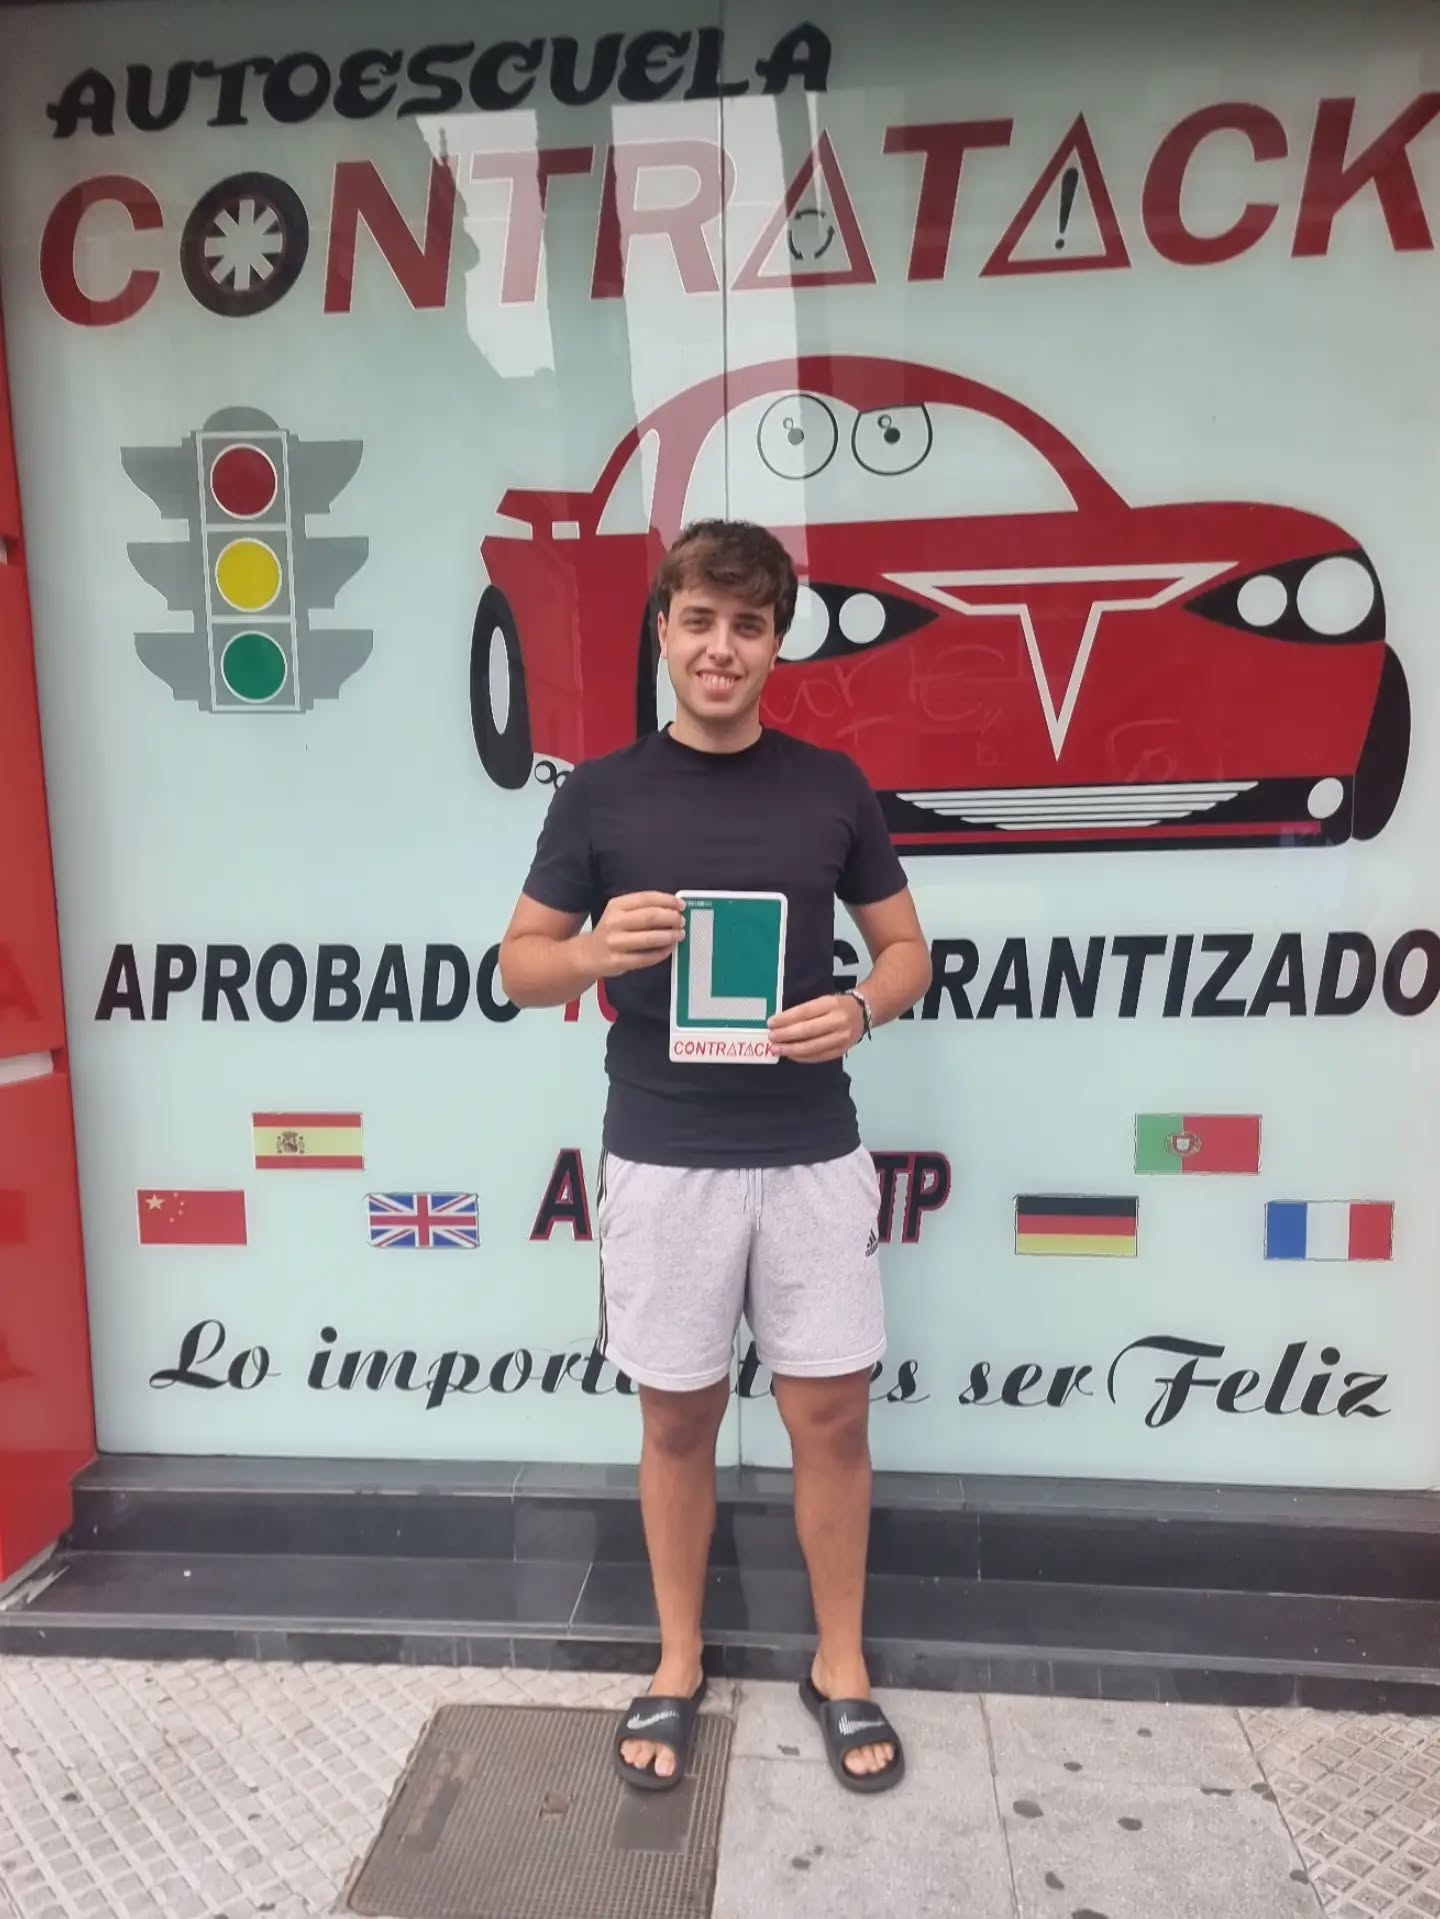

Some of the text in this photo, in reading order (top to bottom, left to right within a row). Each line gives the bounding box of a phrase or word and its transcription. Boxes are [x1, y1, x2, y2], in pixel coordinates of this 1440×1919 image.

[46, 21, 832, 138] AUTOESCUELA
[40, 92, 1440, 327] CONTRATACK
[95, 943, 522, 1023] APROBADO
[833, 929, 1440, 1020] RANTIZADO
[688, 909, 767, 1020] L
[149, 1319, 281, 1389] Lo
[307, 1326, 774, 1410] importt
[958, 1359, 1093, 1407] ser
[1107, 1334, 1391, 1428] Feliz
